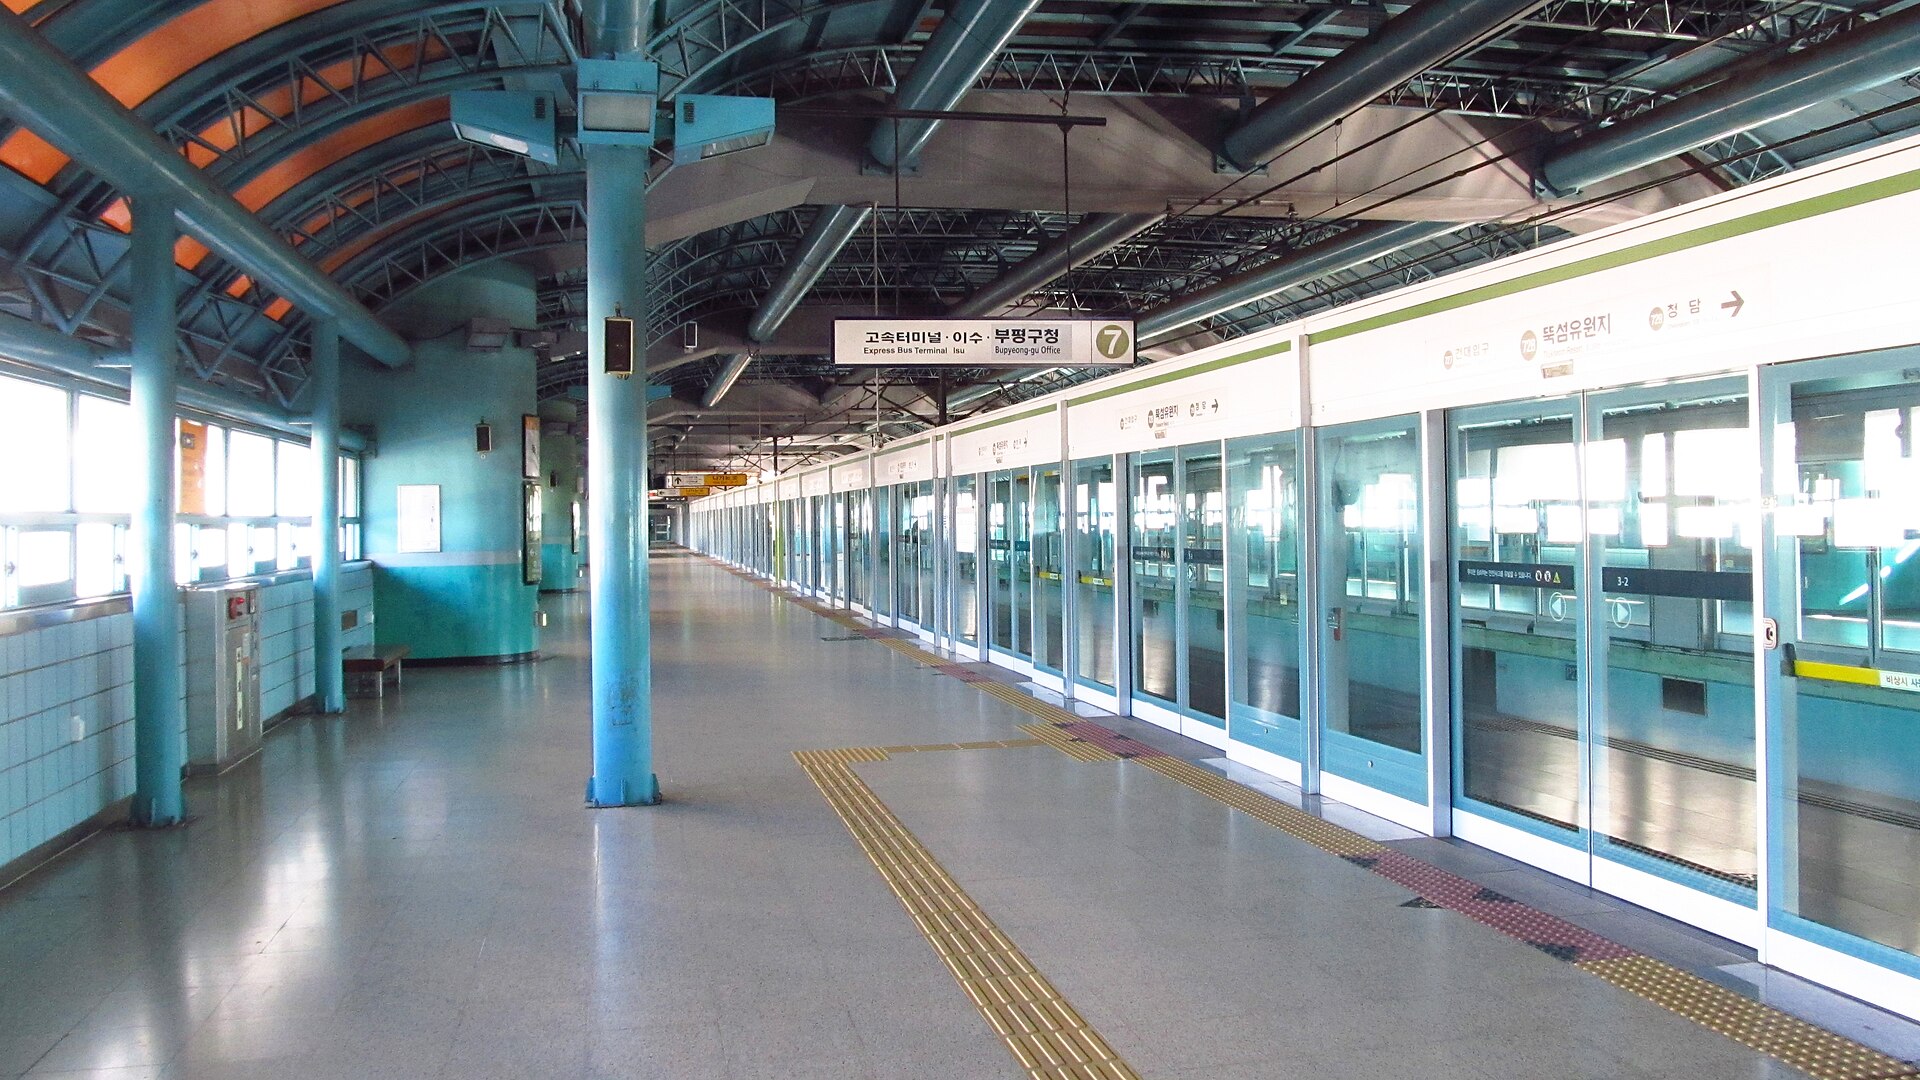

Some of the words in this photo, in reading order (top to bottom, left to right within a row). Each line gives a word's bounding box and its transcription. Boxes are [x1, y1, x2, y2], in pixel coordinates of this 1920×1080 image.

[865, 331, 942, 344] 고속터미널
[953, 331, 983, 344] 이수
[994, 328, 1060, 344] 부평구청
[1542, 312, 1611, 345] 뚝섬유원지
[1103, 329, 1122, 355] 7
[1521, 338, 1536, 353] 728
[863, 347, 896, 356] Express
[897, 346, 913, 354] Bus
[914, 346, 948, 355] Terminal
[953, 347, 965, 355] Isu
[994, 345, 1040, 356] Bupyeong-gu
[1040, 345, 1061, 354] Office
[1617, 576, 1629, 587] 3-2
[1885, 675, 1909, 687] 비상시
